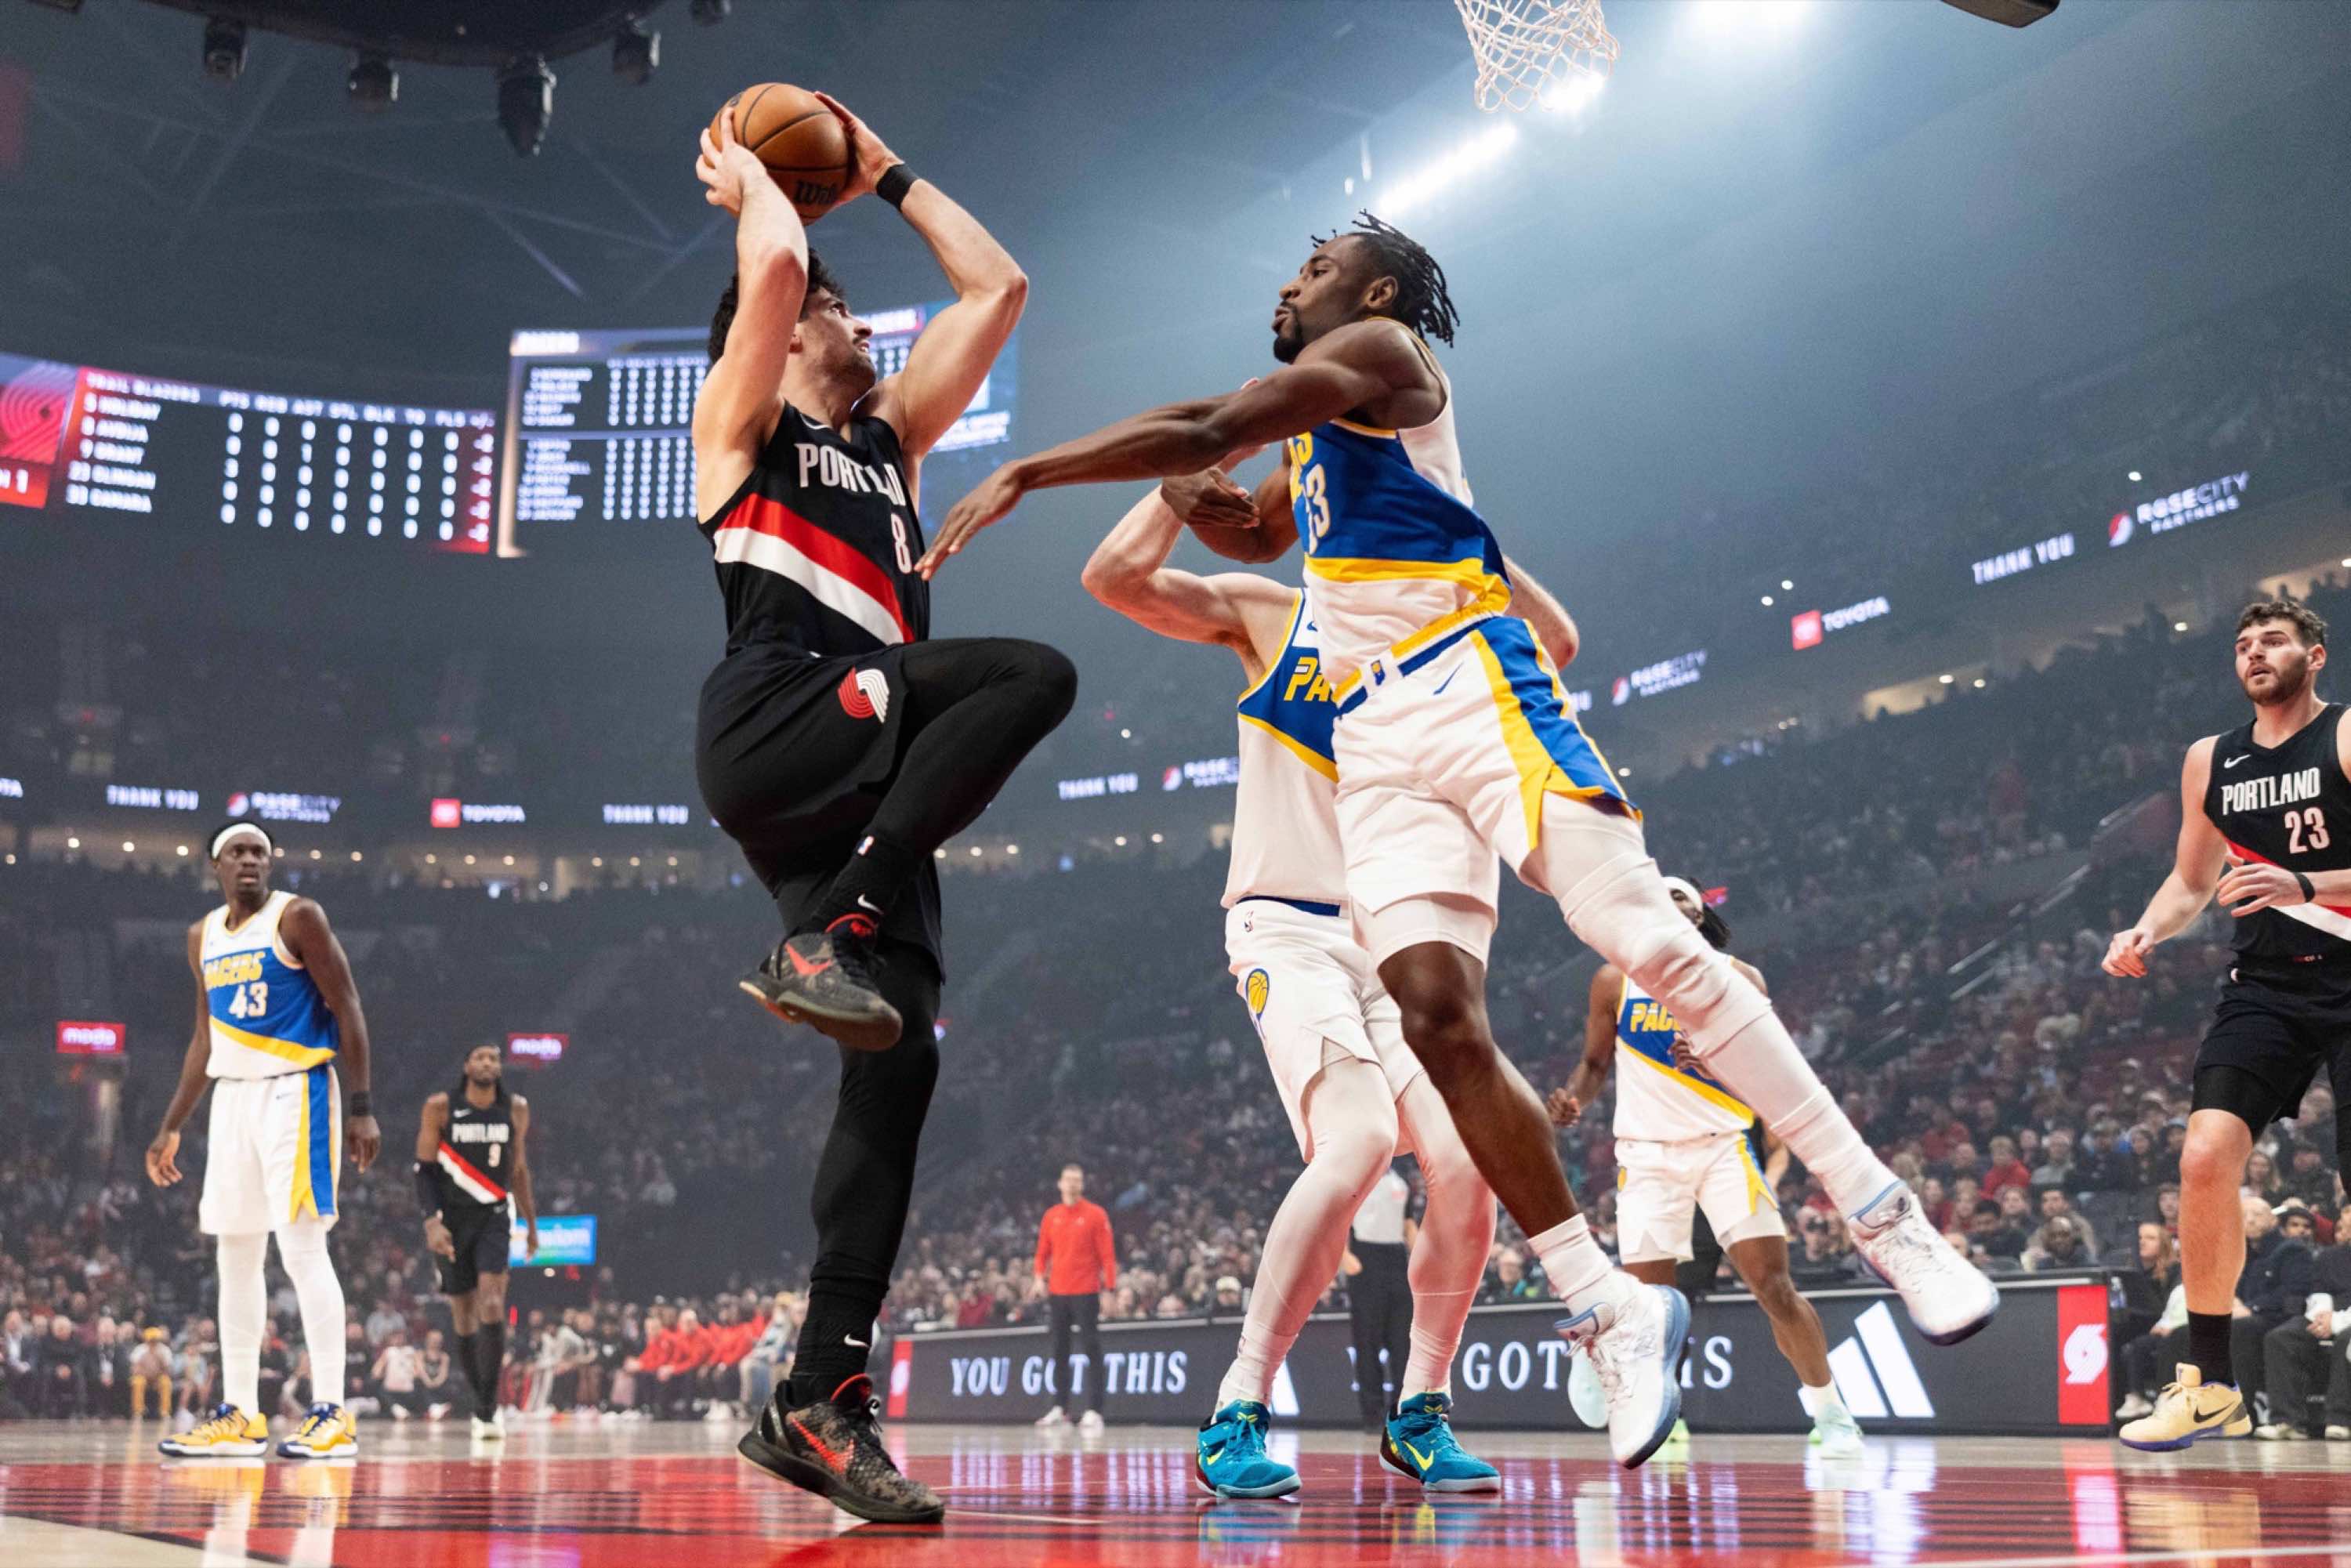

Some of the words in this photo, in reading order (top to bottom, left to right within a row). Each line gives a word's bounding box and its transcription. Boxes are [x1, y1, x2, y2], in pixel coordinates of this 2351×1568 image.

[890, 512, 912, 574] 8
[1972, 547, 2032, 584] THANK
[2035, 533, 2074, 564] YOU
[1821, 596, 1890, 632] TOYOTA
[462, 804, 526, 823] TOYOTA
[2221, 767, 2321, 816] PORTLAND
[2284, 806, 2331, 854] 23
[228, 982, 269, 1019] 43
[451, 1123, 509, 1143] PORTLAND
[950, 1356, 1010, 1396] YOU
[1103, 1350, 1188, 1395] THIS
[1462, 1340, 1567, 1392] GOT
